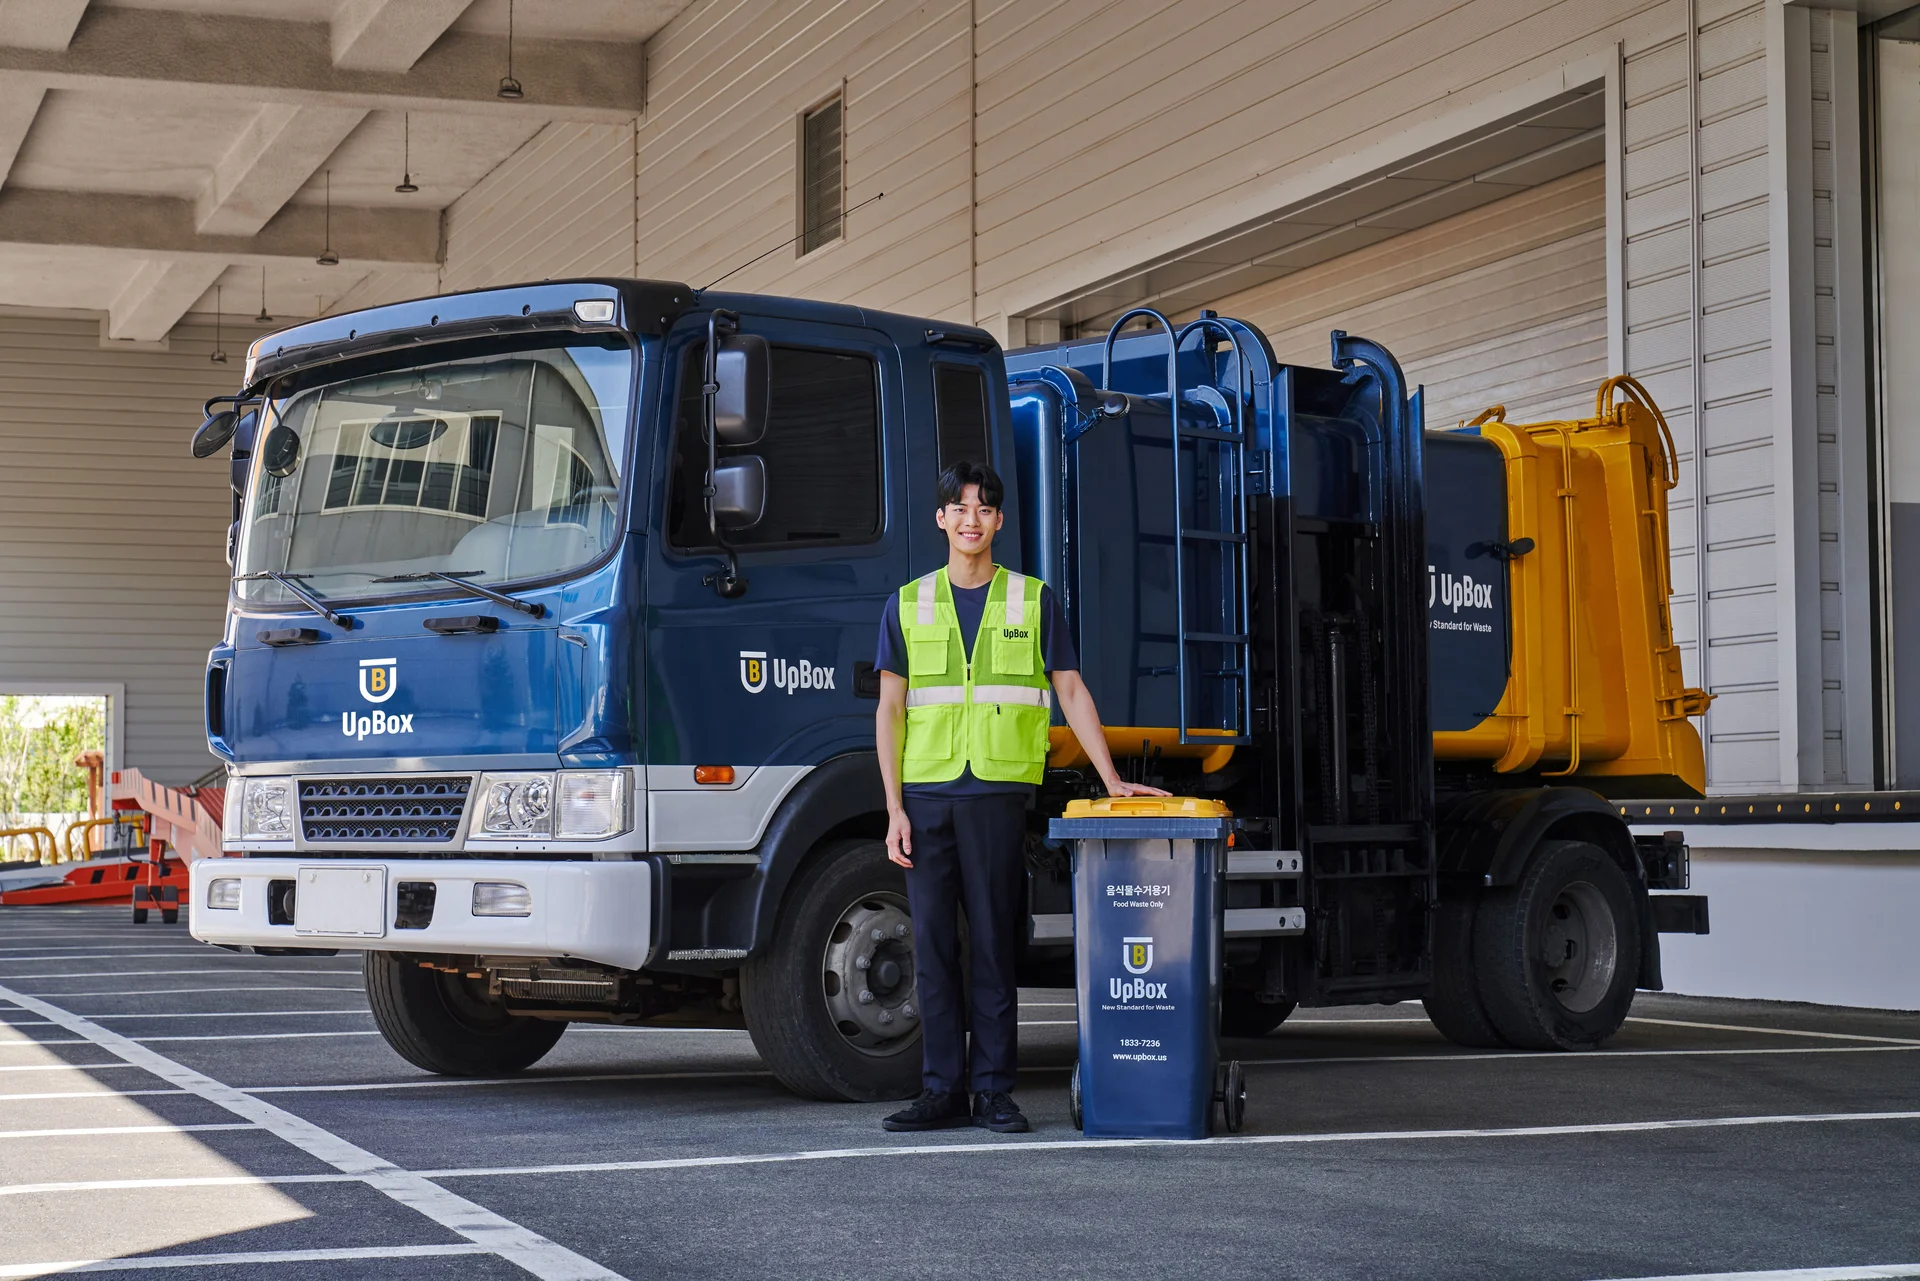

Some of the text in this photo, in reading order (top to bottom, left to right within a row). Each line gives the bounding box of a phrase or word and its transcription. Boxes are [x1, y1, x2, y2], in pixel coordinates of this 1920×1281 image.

[1441, 573, 1493, 613] UpBox
[1433, 620, 1463, 631] Standard
[1463, 622, 1472, 631] for
[1473, 622, 1492, 633] Waste
[1003, 628, 1028, 640] UpBox
[773, 658, 835, 695] UpBox
[342, 710, 414, 741] UpBox
[1106, 884, 1171, 897] 음식물수거용기
[1113, 900, 1164, 909] Food Waste Only
[1110, 978, 1168, 1003] UpBox
[1120, 1039, 1161, 1048] 1833-7236
[1112, 1053, 1168, 1062] www.upbox.us
